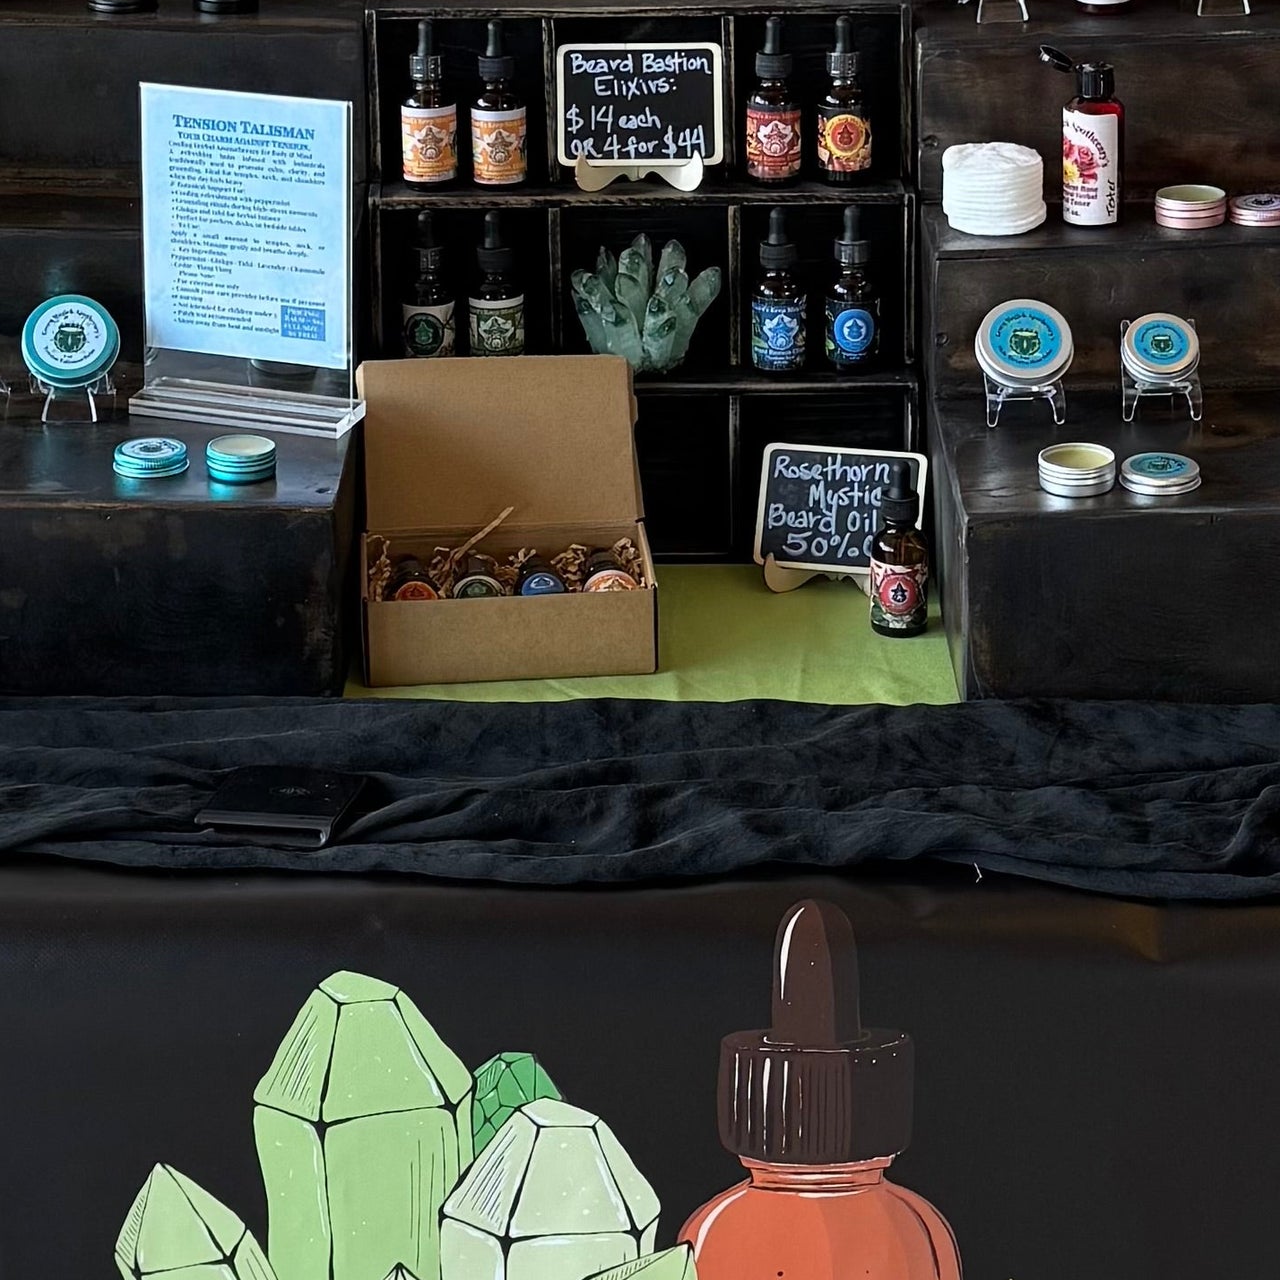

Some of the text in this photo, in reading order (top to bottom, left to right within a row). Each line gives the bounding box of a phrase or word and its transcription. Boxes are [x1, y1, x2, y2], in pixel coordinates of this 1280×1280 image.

[570, 52, 712, 75] Beard Bastion
[595, 75, 677, 100] Elixirs:
[172, 114, 315, 140] TENSION TALISMAN
[618, 106, 661, 129] each
[570, 125, 706, 159] OR 4 for $44
[773, 453, 890, 483] Rosethorn
[809, 480, 882, 515] Mystic
[768, 503, 877, 535] Beard Oil
[782, 531, 860, 558] 50%
